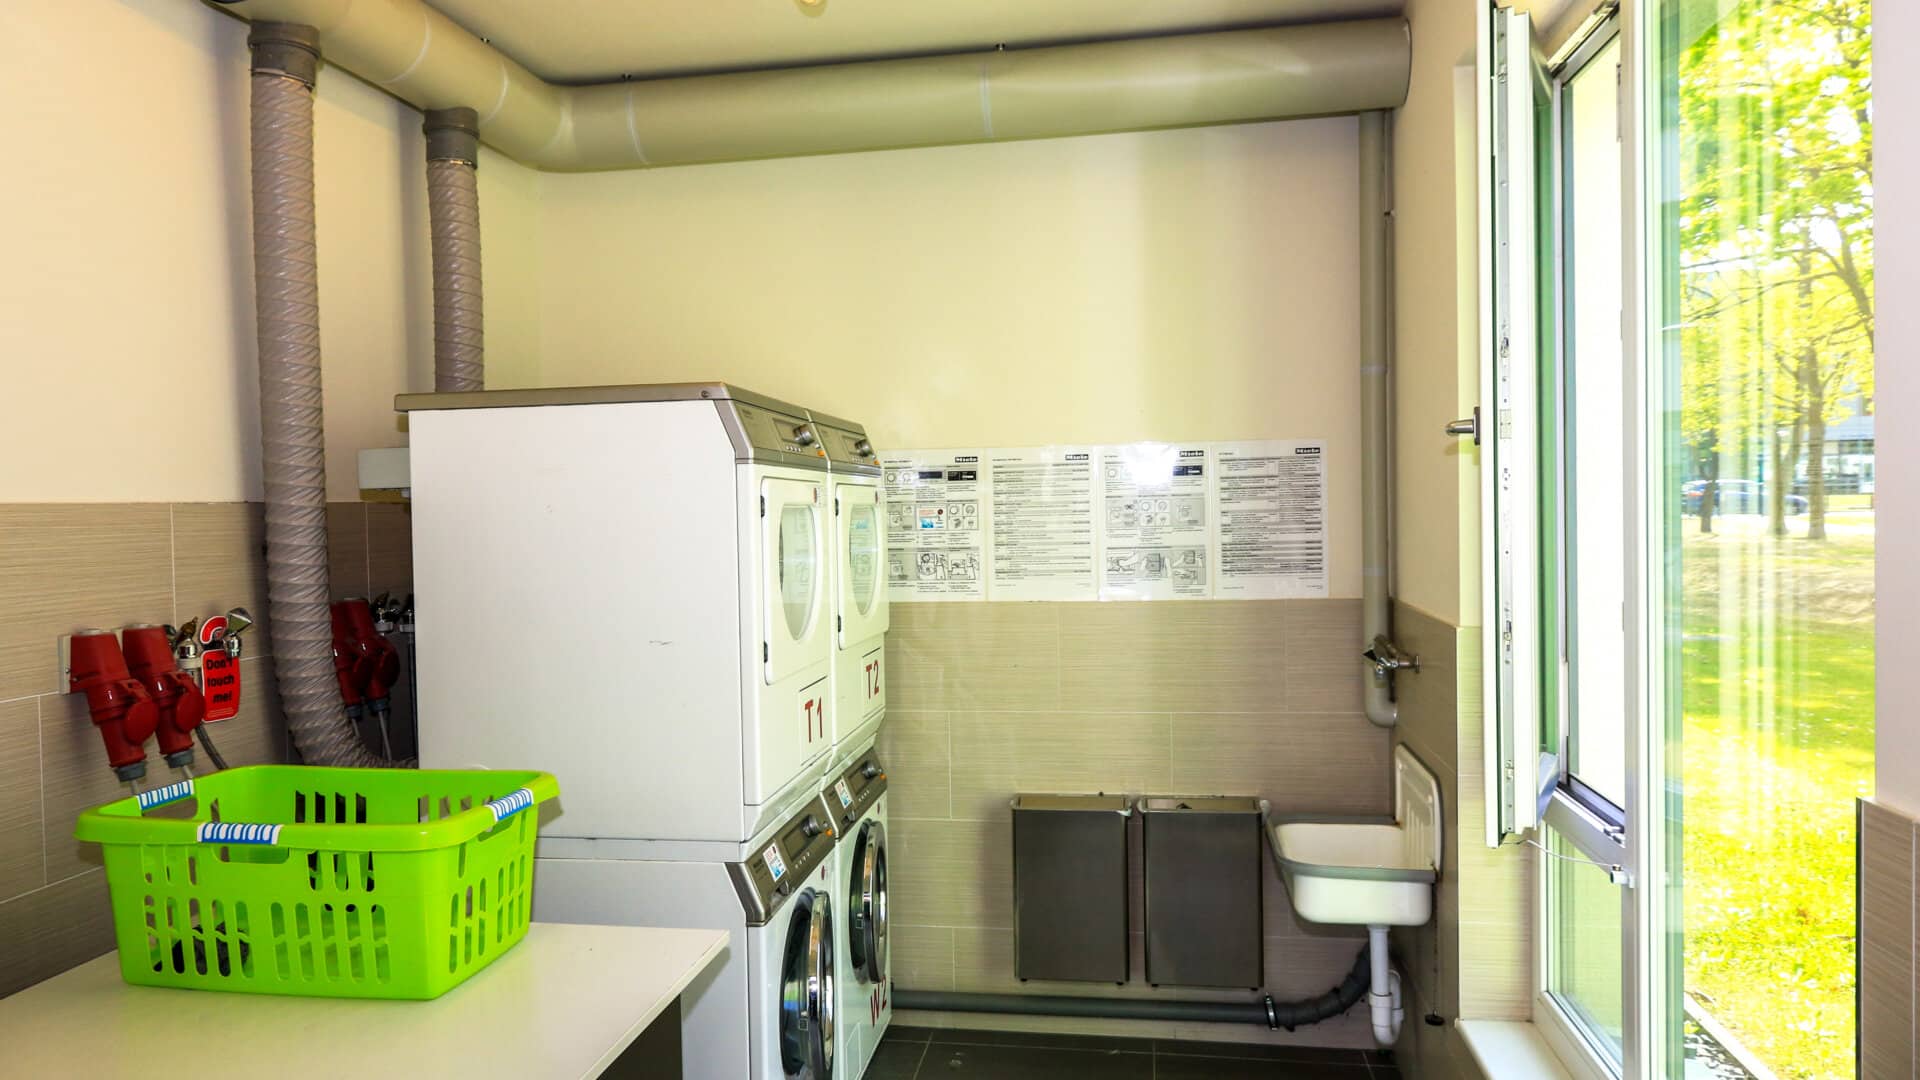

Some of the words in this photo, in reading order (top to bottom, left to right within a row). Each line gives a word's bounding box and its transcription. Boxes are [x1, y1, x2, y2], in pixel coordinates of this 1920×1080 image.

[207, 674, 235, 687] touch
[212, 691, 232, 703] me!
[866, 659, 879, 699] T2
[805, 696, 823, 743] T1
[870, 974, 887, 1028] W2
